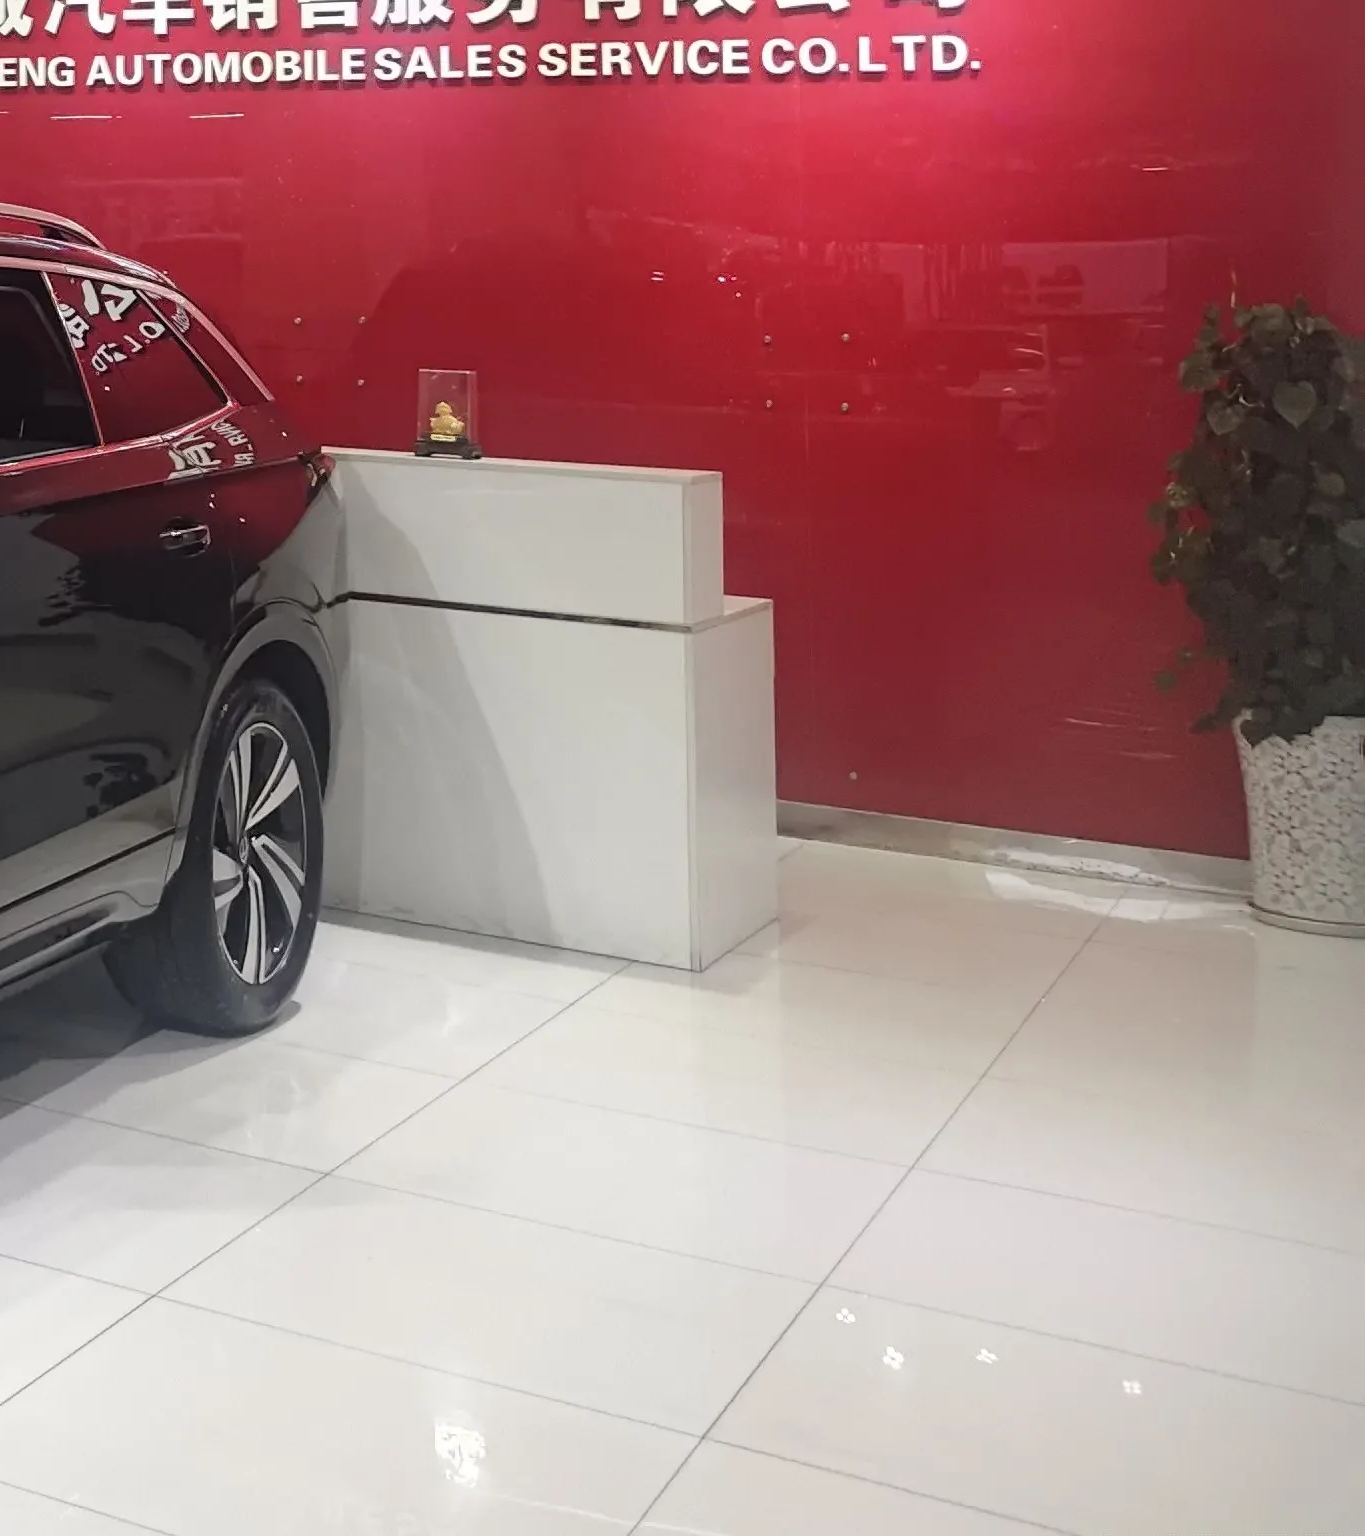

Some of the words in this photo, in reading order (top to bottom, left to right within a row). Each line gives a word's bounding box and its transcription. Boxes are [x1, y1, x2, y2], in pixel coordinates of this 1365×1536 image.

[86, 48, 366, 86] AUTOMOBILE
[373, 43, 527, 81] SALES
[536, 38, 750, 77] SERVICE
